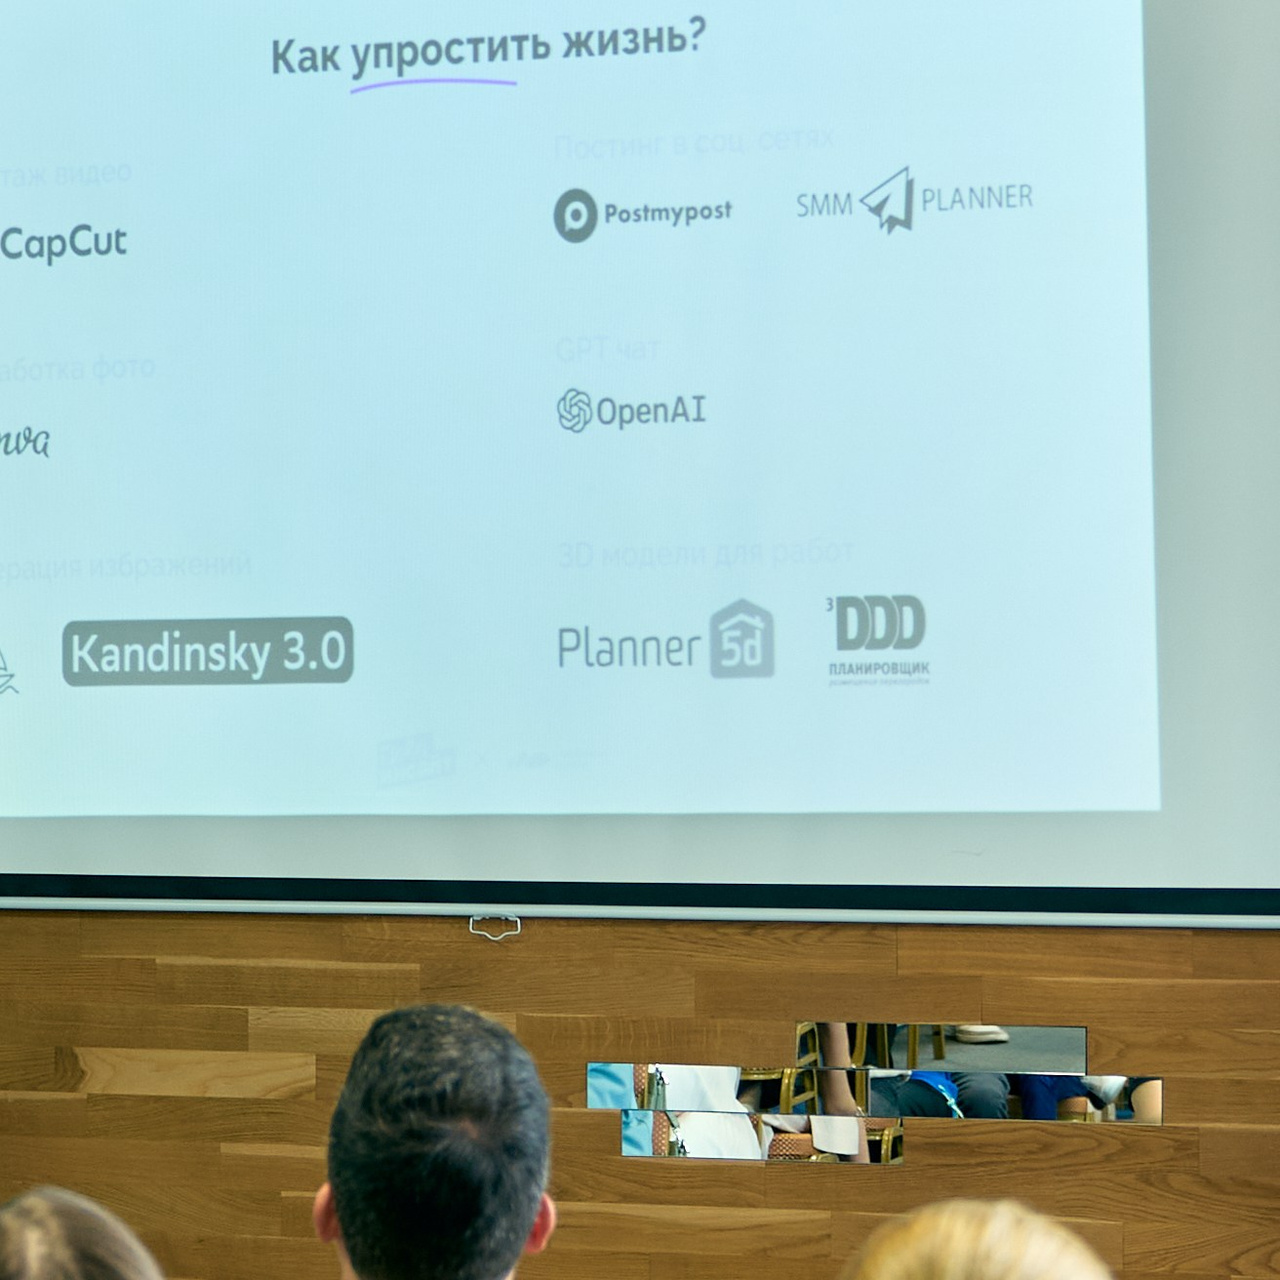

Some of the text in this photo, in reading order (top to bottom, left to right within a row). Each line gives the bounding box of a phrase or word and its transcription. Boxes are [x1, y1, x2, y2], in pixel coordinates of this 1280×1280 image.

[272, 14, 707, 80] Как упростить жизнь?
[555, 134, 666, 158] Постинг
[673, 137, 688, 155] в
[758, 128, 835, 151] сетях
[55, 163, 132, 187] видео
[604, 200, 733, 228] Postmypost
[796, 183, 1033, 218] SMM PLANNER
[0, 223, 128, 266] CapCut
[556, 334, 661, 363] GPT чат
[92, 355, 156, 386] фото
[596, 394, 707, 431] OpenAI
[559, 536, 856, 569] 3D модели для работ
[72, 630, 346, 680] Kandinsky 3.0
[558, 625, 702, 669] Planner
[828, 661, 930, 677] ПЛАНИРОВЩИК
